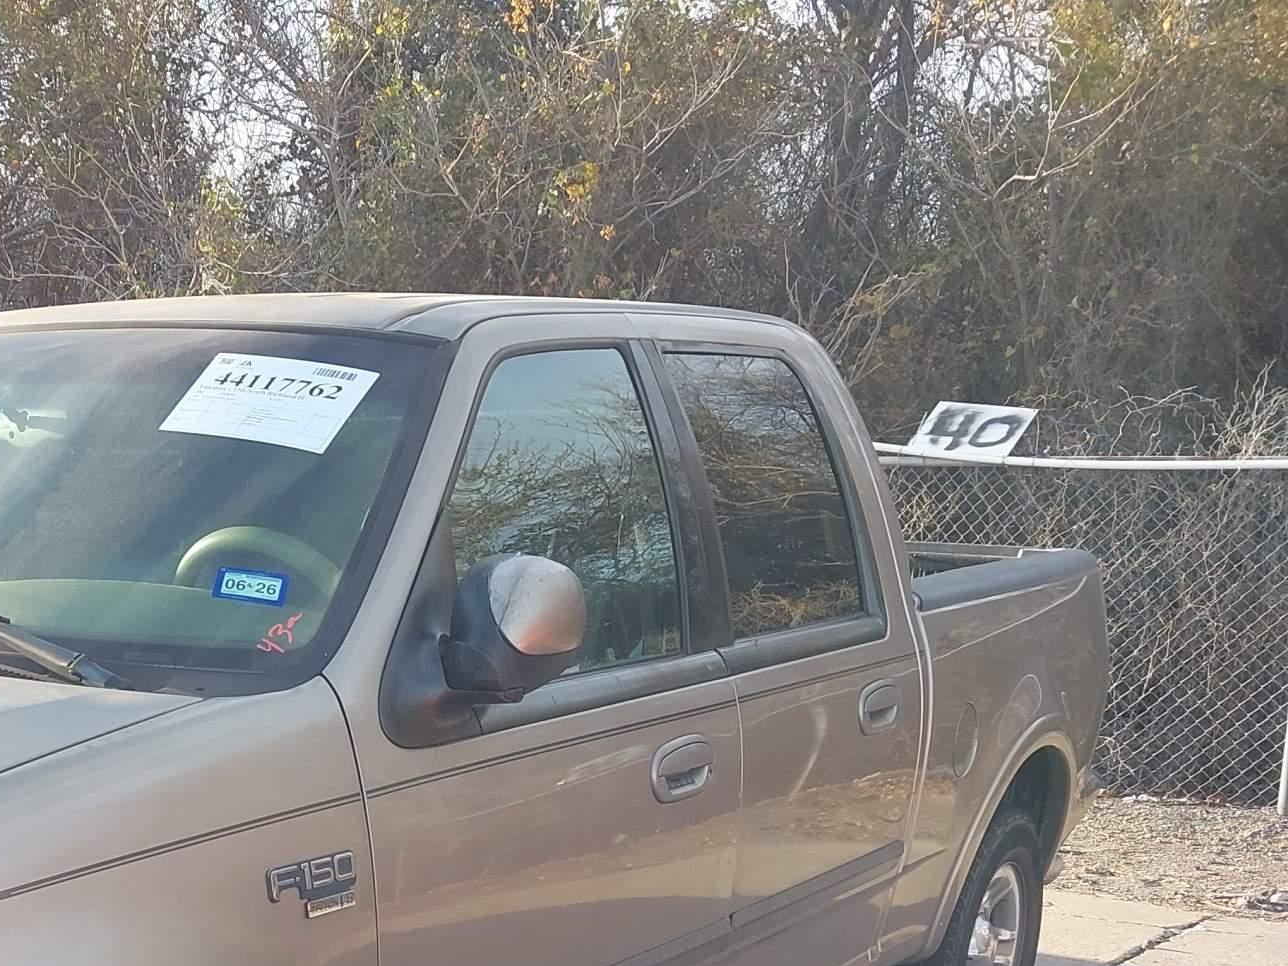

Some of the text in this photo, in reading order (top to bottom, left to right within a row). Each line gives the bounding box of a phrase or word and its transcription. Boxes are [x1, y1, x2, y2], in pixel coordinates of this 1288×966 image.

[214, 371, 343, 400] 44117762
[924, 406, 1024, 450] 40
[224, 578, 278, 595] 06 26
[269, 851, 356, 901] F-150
